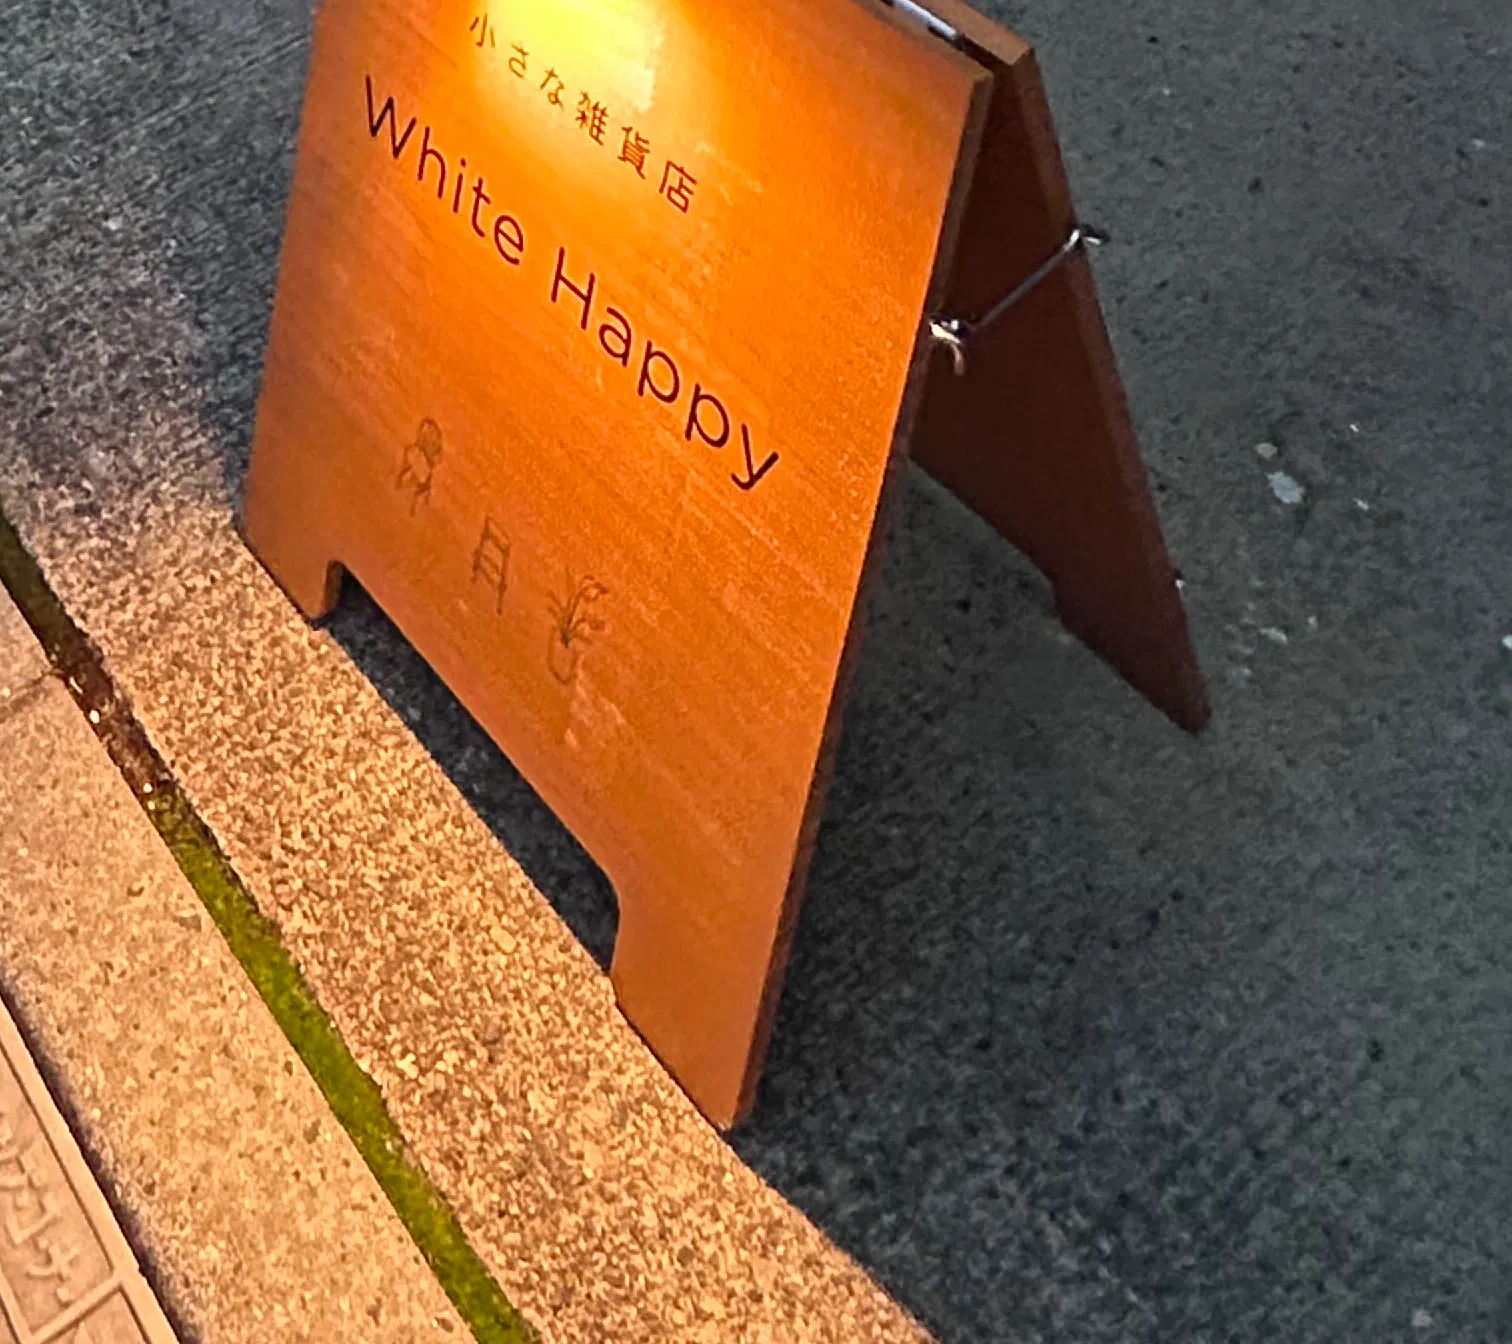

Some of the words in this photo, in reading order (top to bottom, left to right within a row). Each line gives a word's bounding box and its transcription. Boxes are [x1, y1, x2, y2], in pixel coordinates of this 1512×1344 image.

[468, 12, 698, 213] 小さな雑貨店
[364, 73, 525, 266] White
[550, 246, 780, 491] Happy
